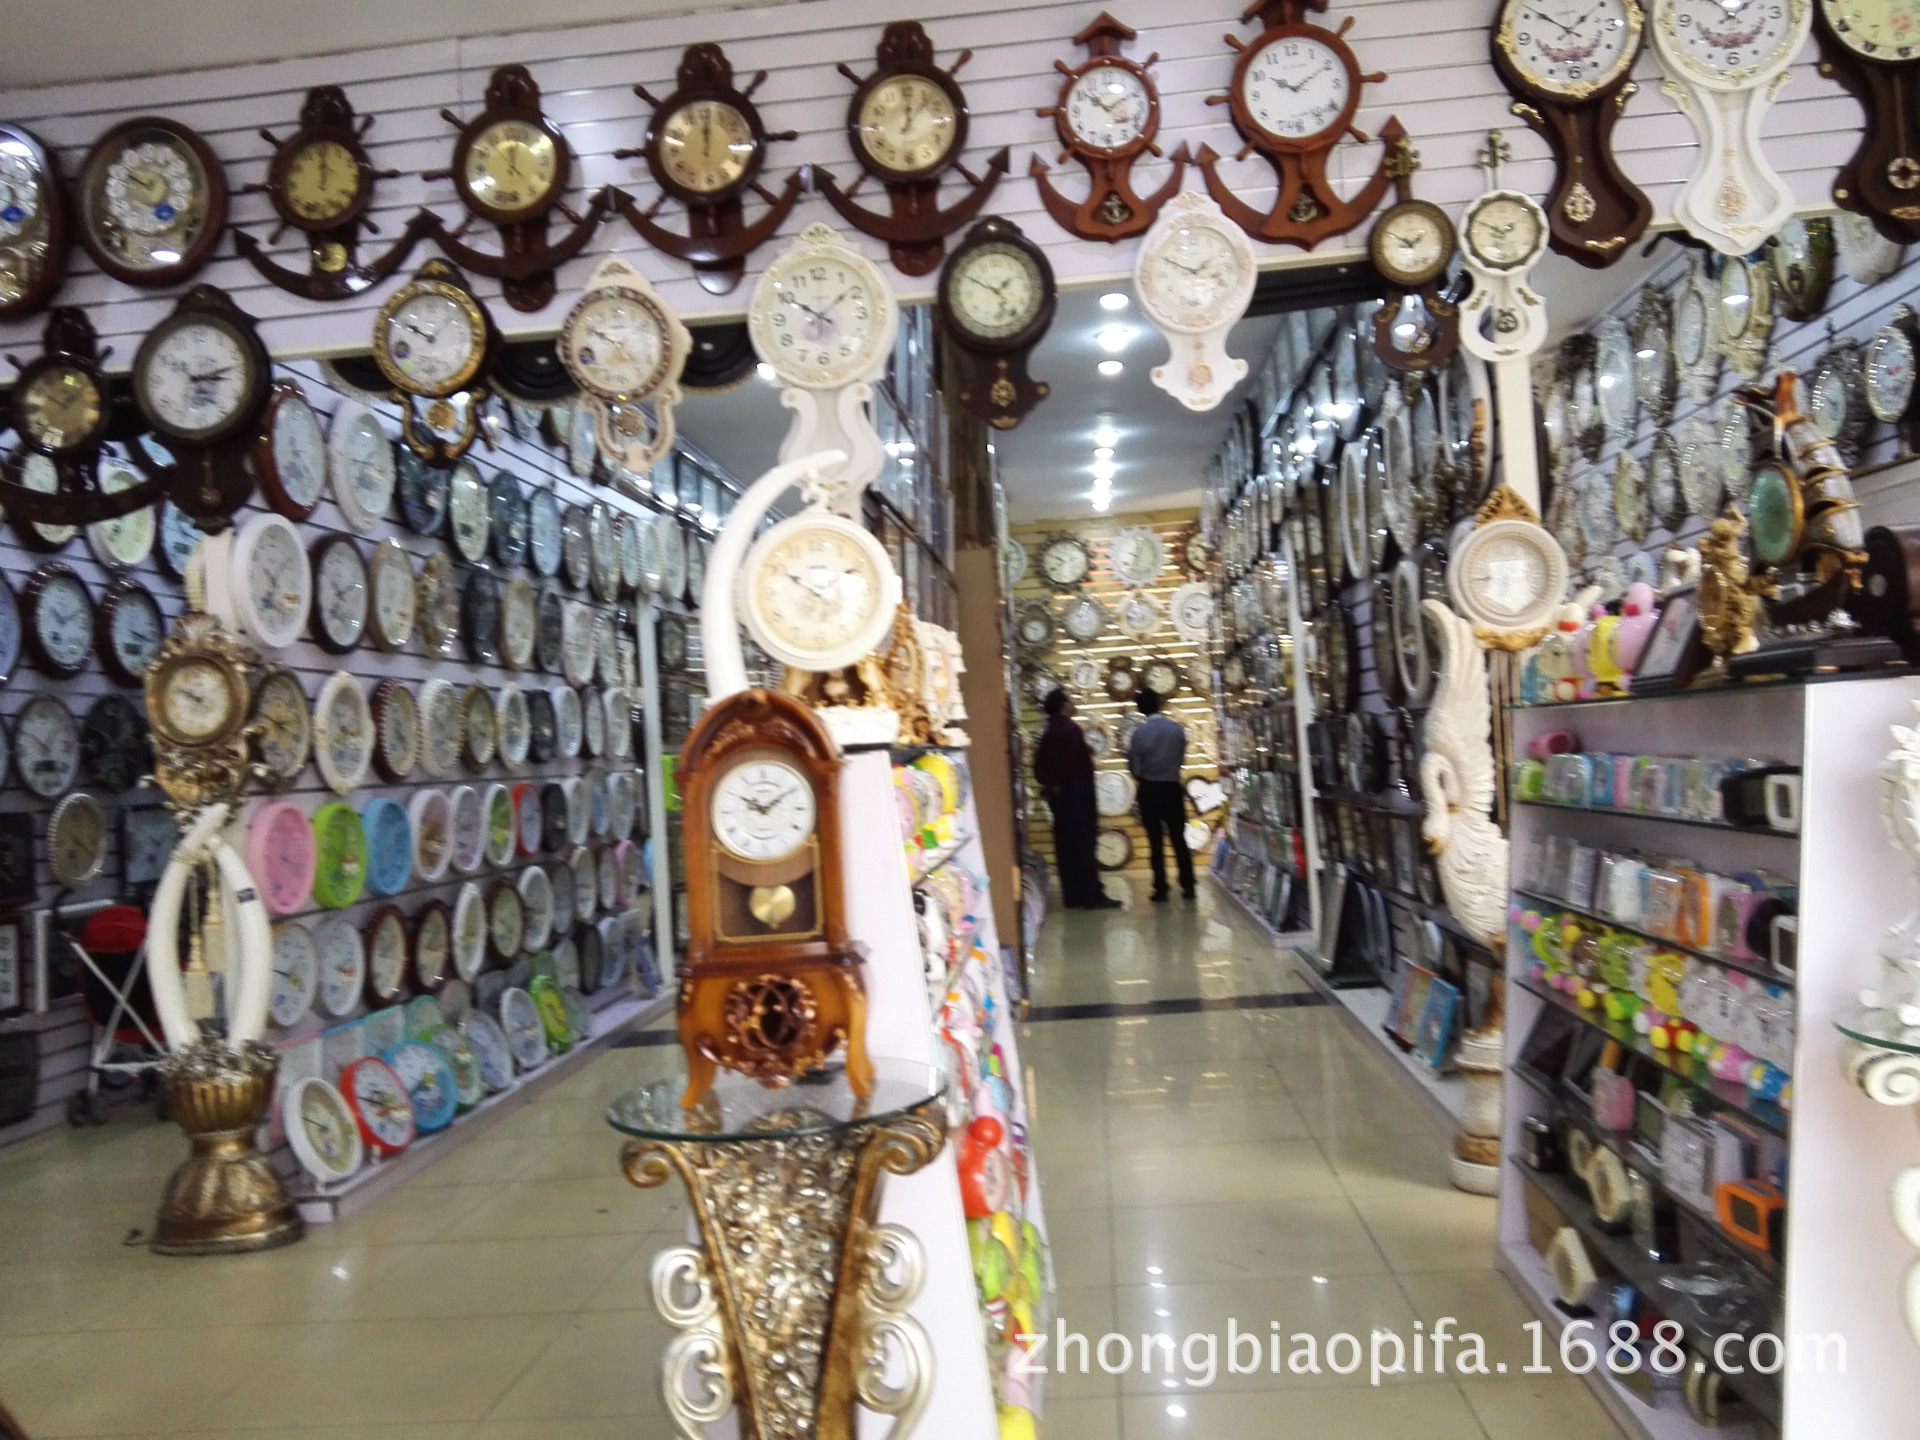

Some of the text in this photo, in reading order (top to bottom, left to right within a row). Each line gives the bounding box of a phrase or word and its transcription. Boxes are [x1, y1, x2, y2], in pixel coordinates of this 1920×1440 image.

[1678, 14, 1692, 28] 9
[1518, 32, 1531, 46] 9
[1726, 52, 1740, 65] 6
[1569, 66, 1581, 79] 6
[809, 267, 827, 280] 12
[792, 276, 807, 288] 11
[772, 313, 786, 327] 9
[816, 351, 830, 366] 6
